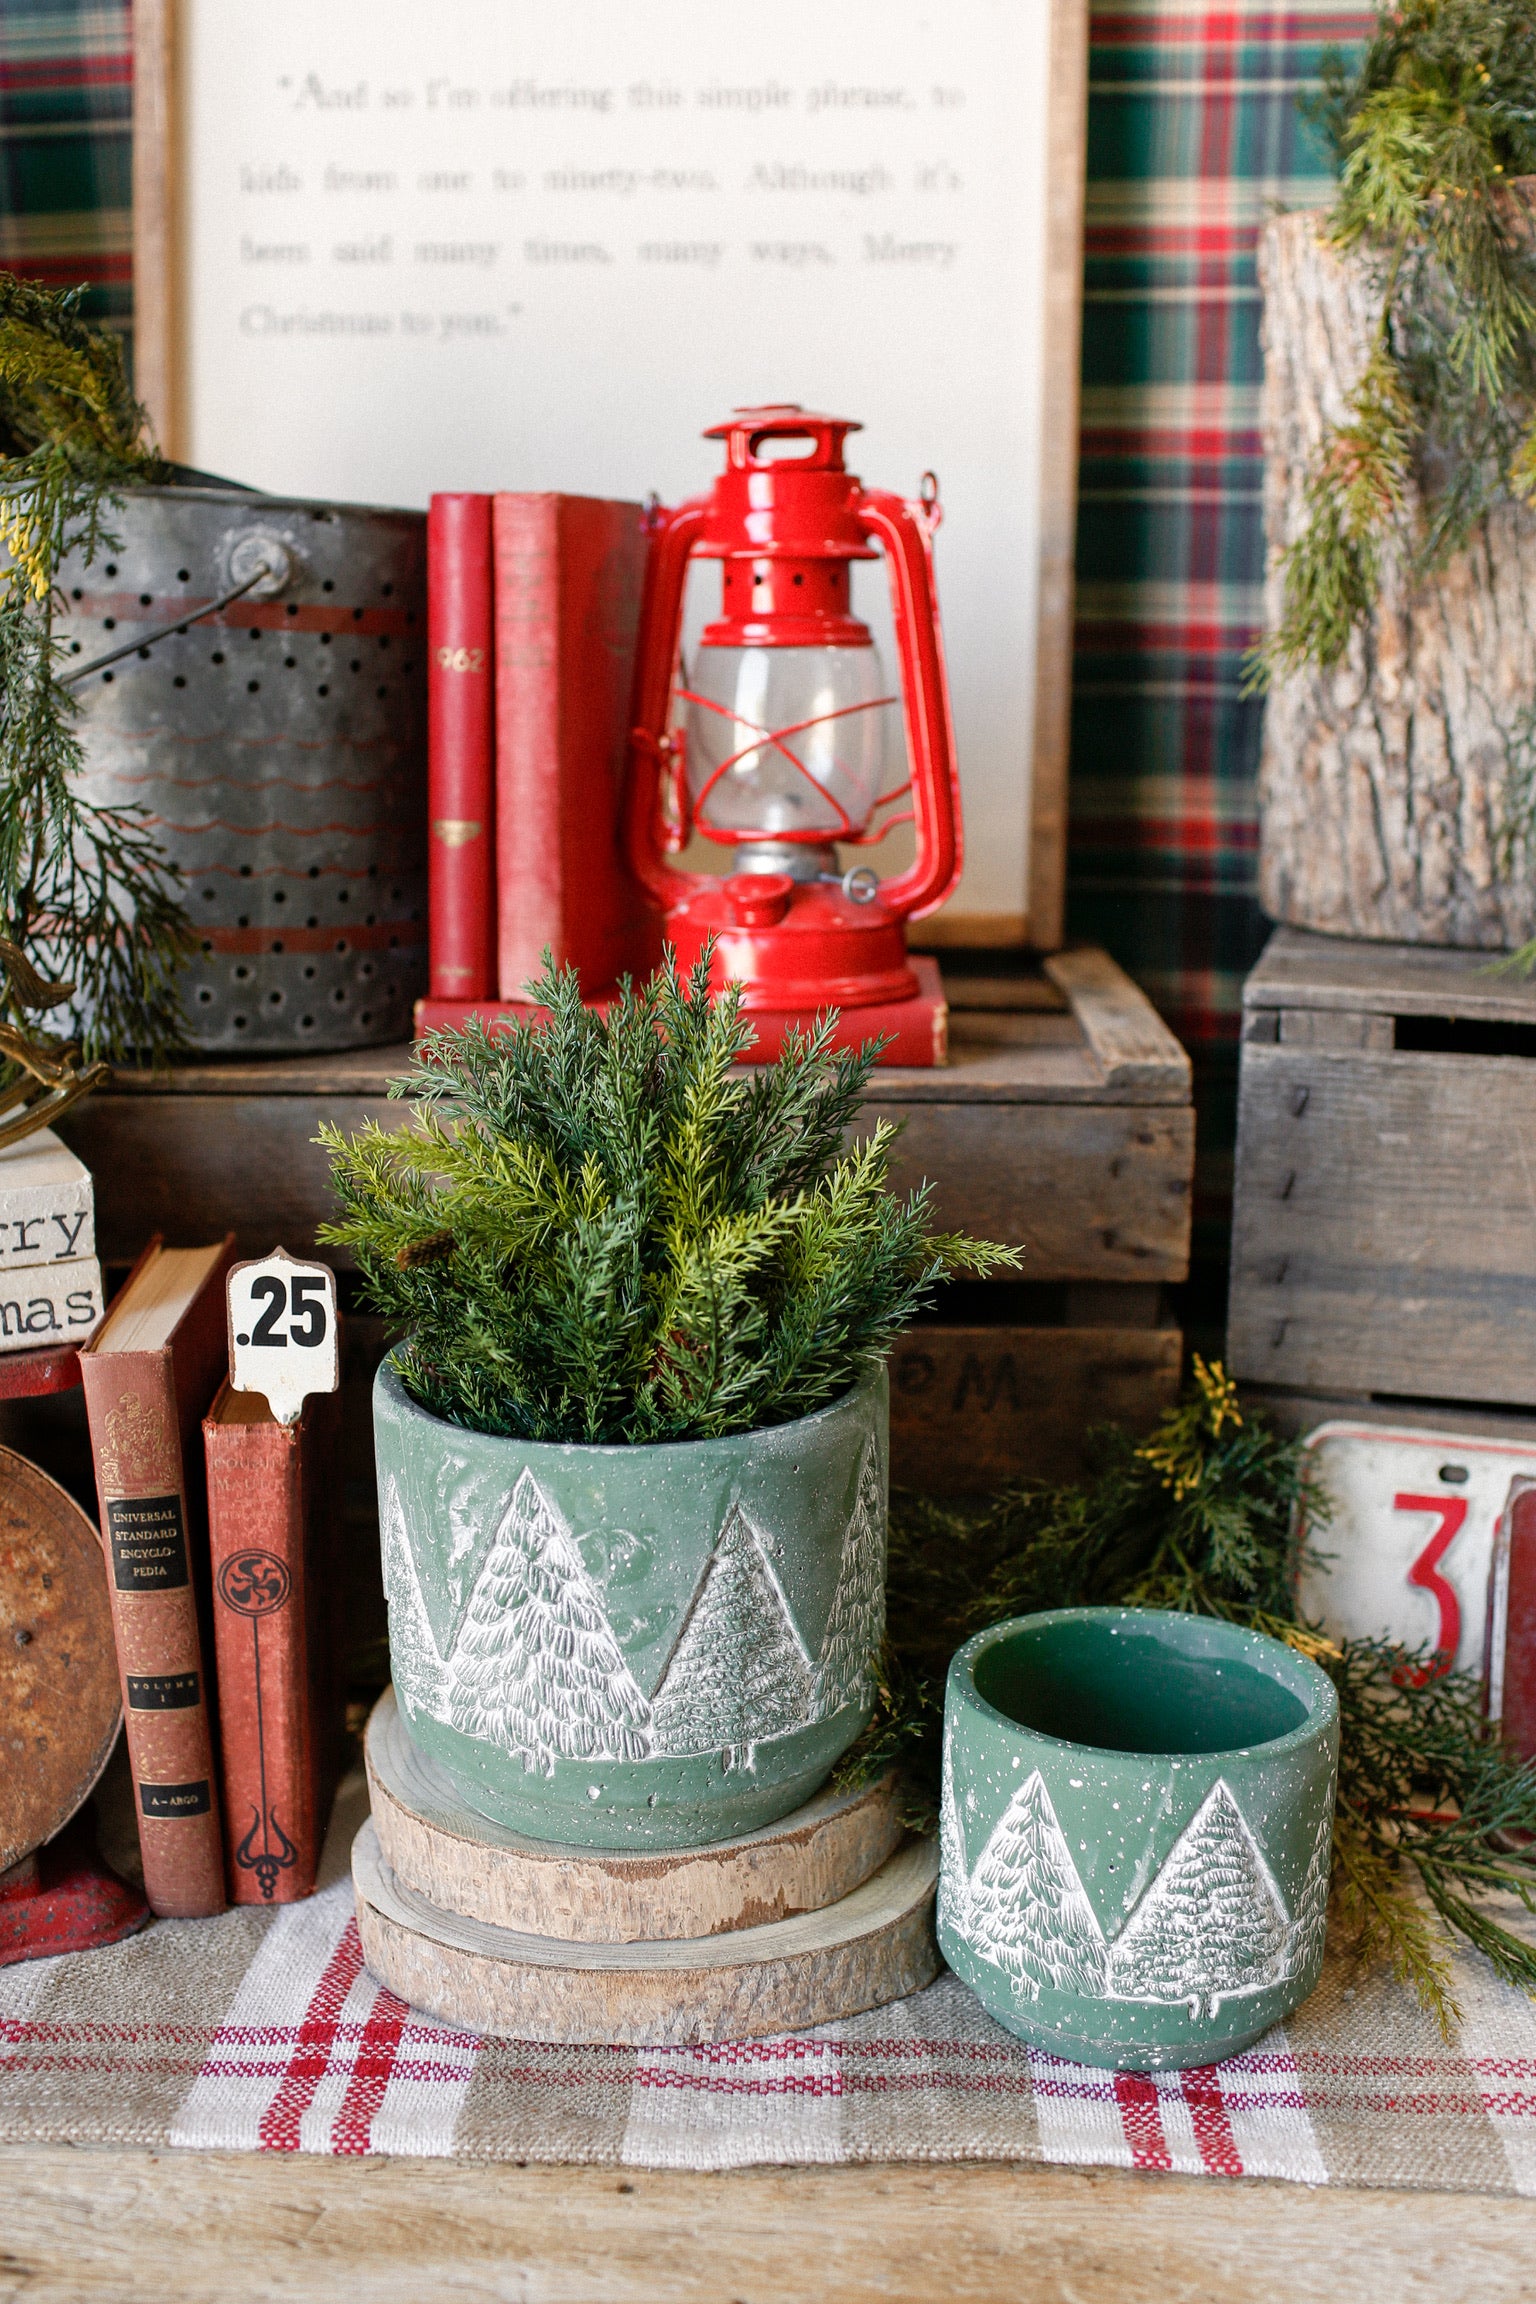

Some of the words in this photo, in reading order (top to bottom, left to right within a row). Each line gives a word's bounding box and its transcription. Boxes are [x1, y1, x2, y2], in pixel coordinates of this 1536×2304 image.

[490, 77, 614, 115] offering
[627, 77, 684, 110] this
[696, 77, 793, 115] simple
[931, 83, 966, 109] to
[239, 162, 303, 195] kids
[323, 161, 397, 194] from
[417, 170, 472, 194] one
[493, 167, 526, 193] to
[748, 161, 893, 197] Although
[239, 234, 311, 266] been
[332, 234, 393, 266] said
[414, 240, 498, 270] many
[637, 240, 723, 270] many
[862, 233, 957, 269] Merry
[239, 303, 392, 338] Christmas
[402, 308, 433, 337] to
[236, 1275, 327, 1348] .25
[113, 1510, 176, 1523] UNIVERSAL
[114, 1528, 177, 1541] STANDARD
[120, 1546, 176, 1559] ENCYCLO-
[133, 1566, 167, 1577] PEDIA
[1393, 1493, 1501, 1689] 3
